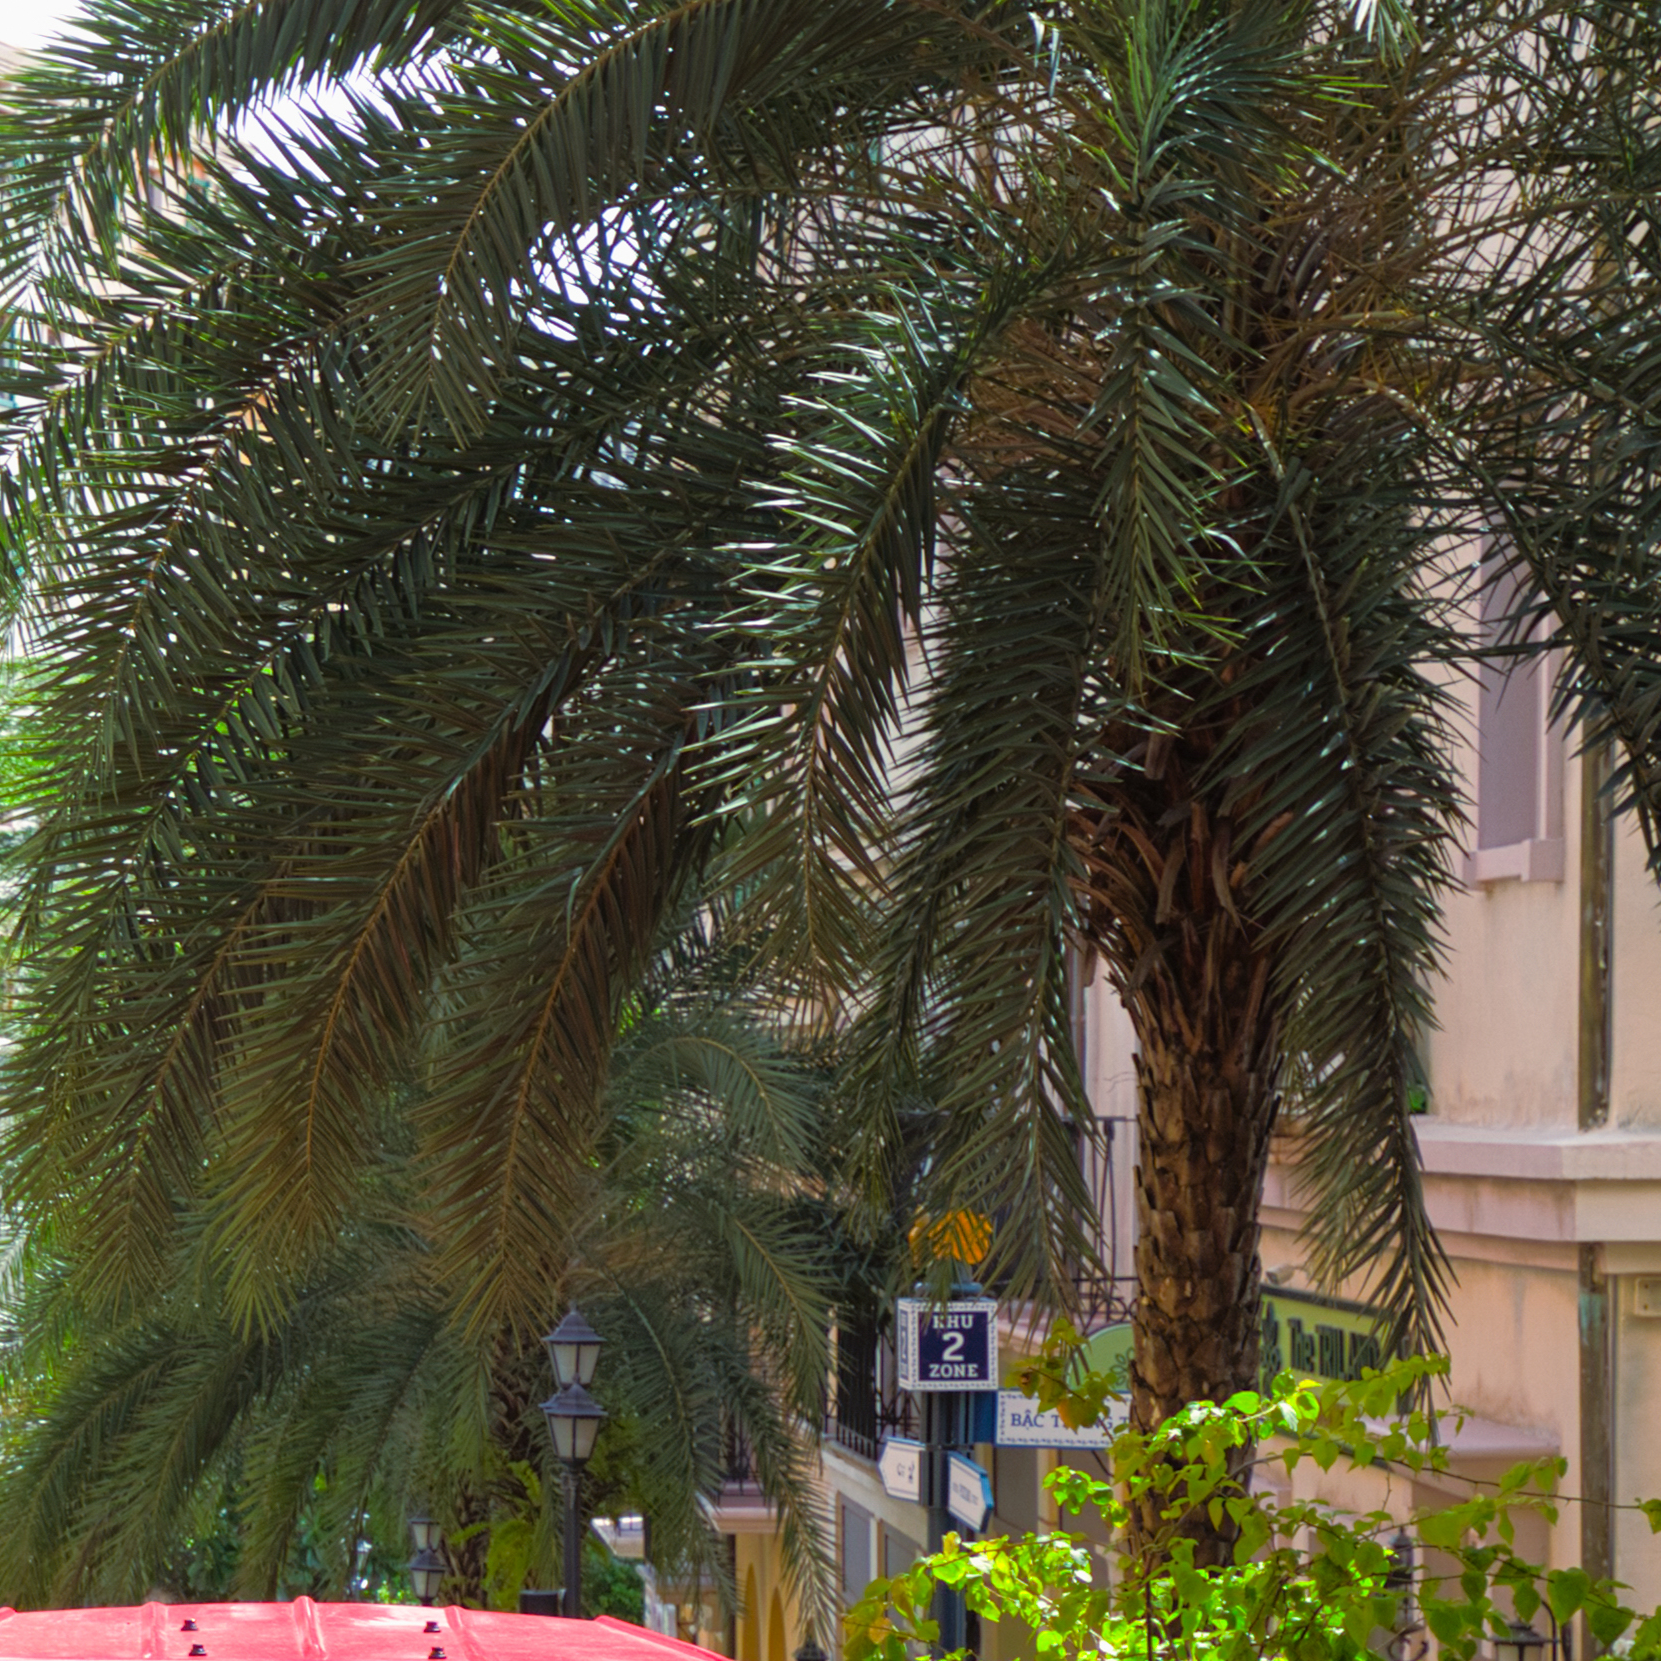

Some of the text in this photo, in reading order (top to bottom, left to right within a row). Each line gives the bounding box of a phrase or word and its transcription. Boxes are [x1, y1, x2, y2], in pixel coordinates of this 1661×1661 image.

[932, 1314, 974, 1329] KHU
[942, 1331, 965, 1361] 2
[928, 1363, 979, 1378] ZONE
[1010, 1409, 1044, 1430] BẬC
